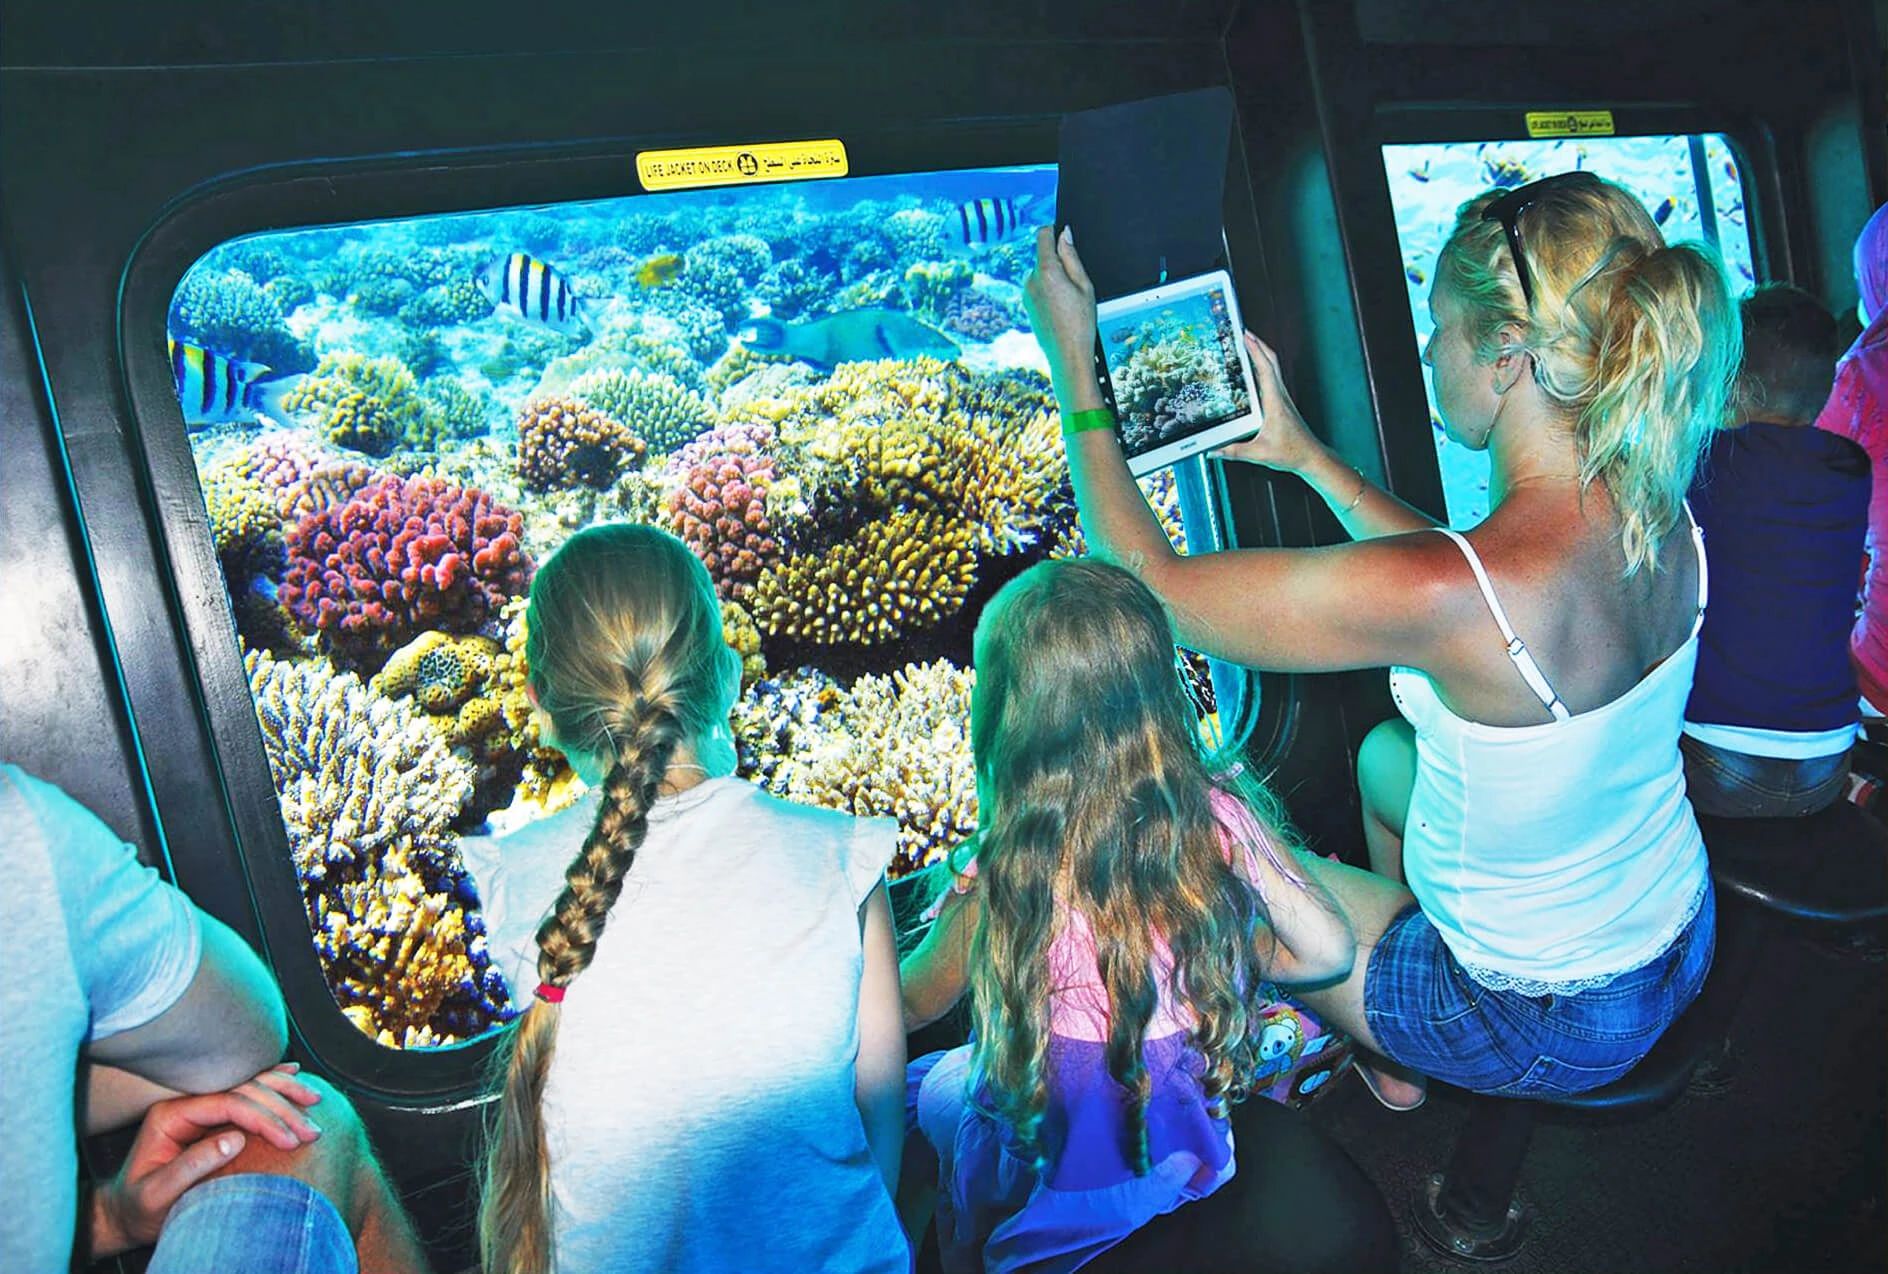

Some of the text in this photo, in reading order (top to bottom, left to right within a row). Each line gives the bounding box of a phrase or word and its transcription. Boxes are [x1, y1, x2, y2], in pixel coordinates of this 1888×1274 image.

[645, 159, 735, 178] LIFE JACKET ON DECK
